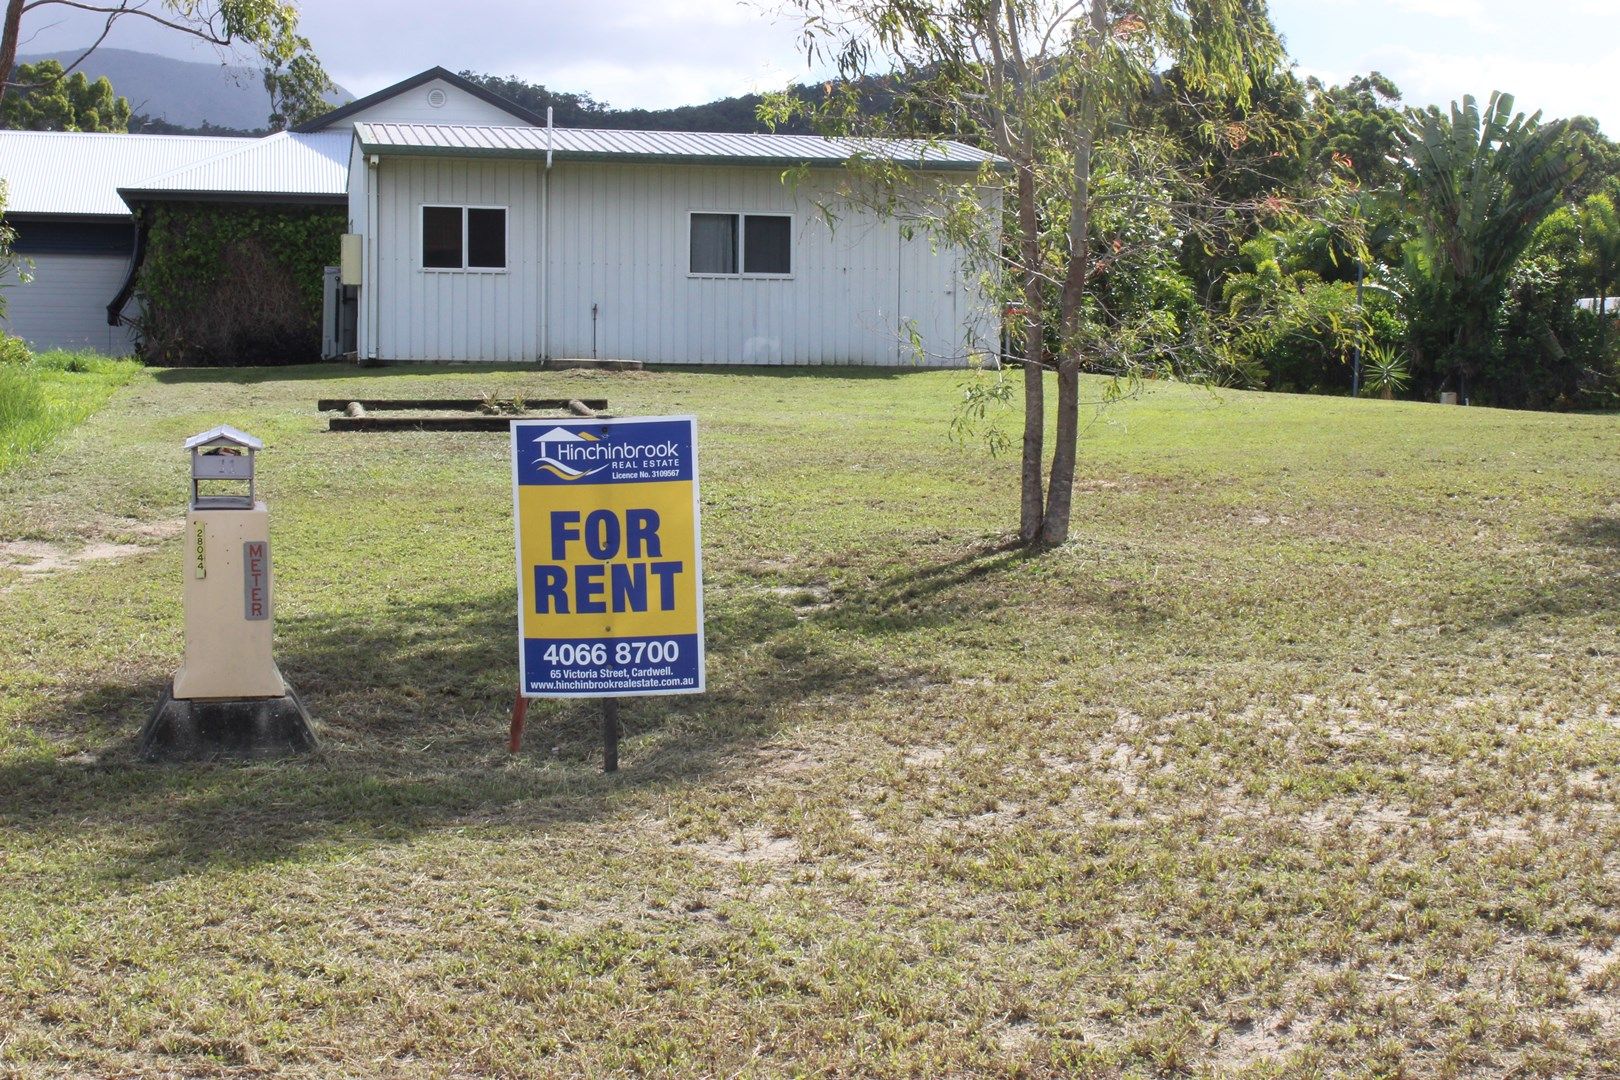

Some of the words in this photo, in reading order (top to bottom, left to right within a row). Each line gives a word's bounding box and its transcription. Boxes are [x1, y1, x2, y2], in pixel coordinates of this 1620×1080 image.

[558, 441, 678, 460] Hinchinbrook
[612, 461, 638, 469] REAL
[643, 458, 680, 468] ESTATE
[612, 472, 638, 480] Licence
[639, 470, 651, 479] No.
[651, 469, 680, 478] 3109567
[551, 509, 662, 560] FOR
[249, 544, 262, 616] METER
[534, 561, 682, 614] RENT
[543, 643, 607, 665] 4066
[615, 641, 679, 664] 8700
[550, 669, 562, 679] 65
[563, 668, 598, 679] Victoria
[599, 668, 630, 678] Street,
[631, 666, 674, 677] Cardwell.
[530, 677, 694, 690] www.hinchinbrookrealestate.com.au
